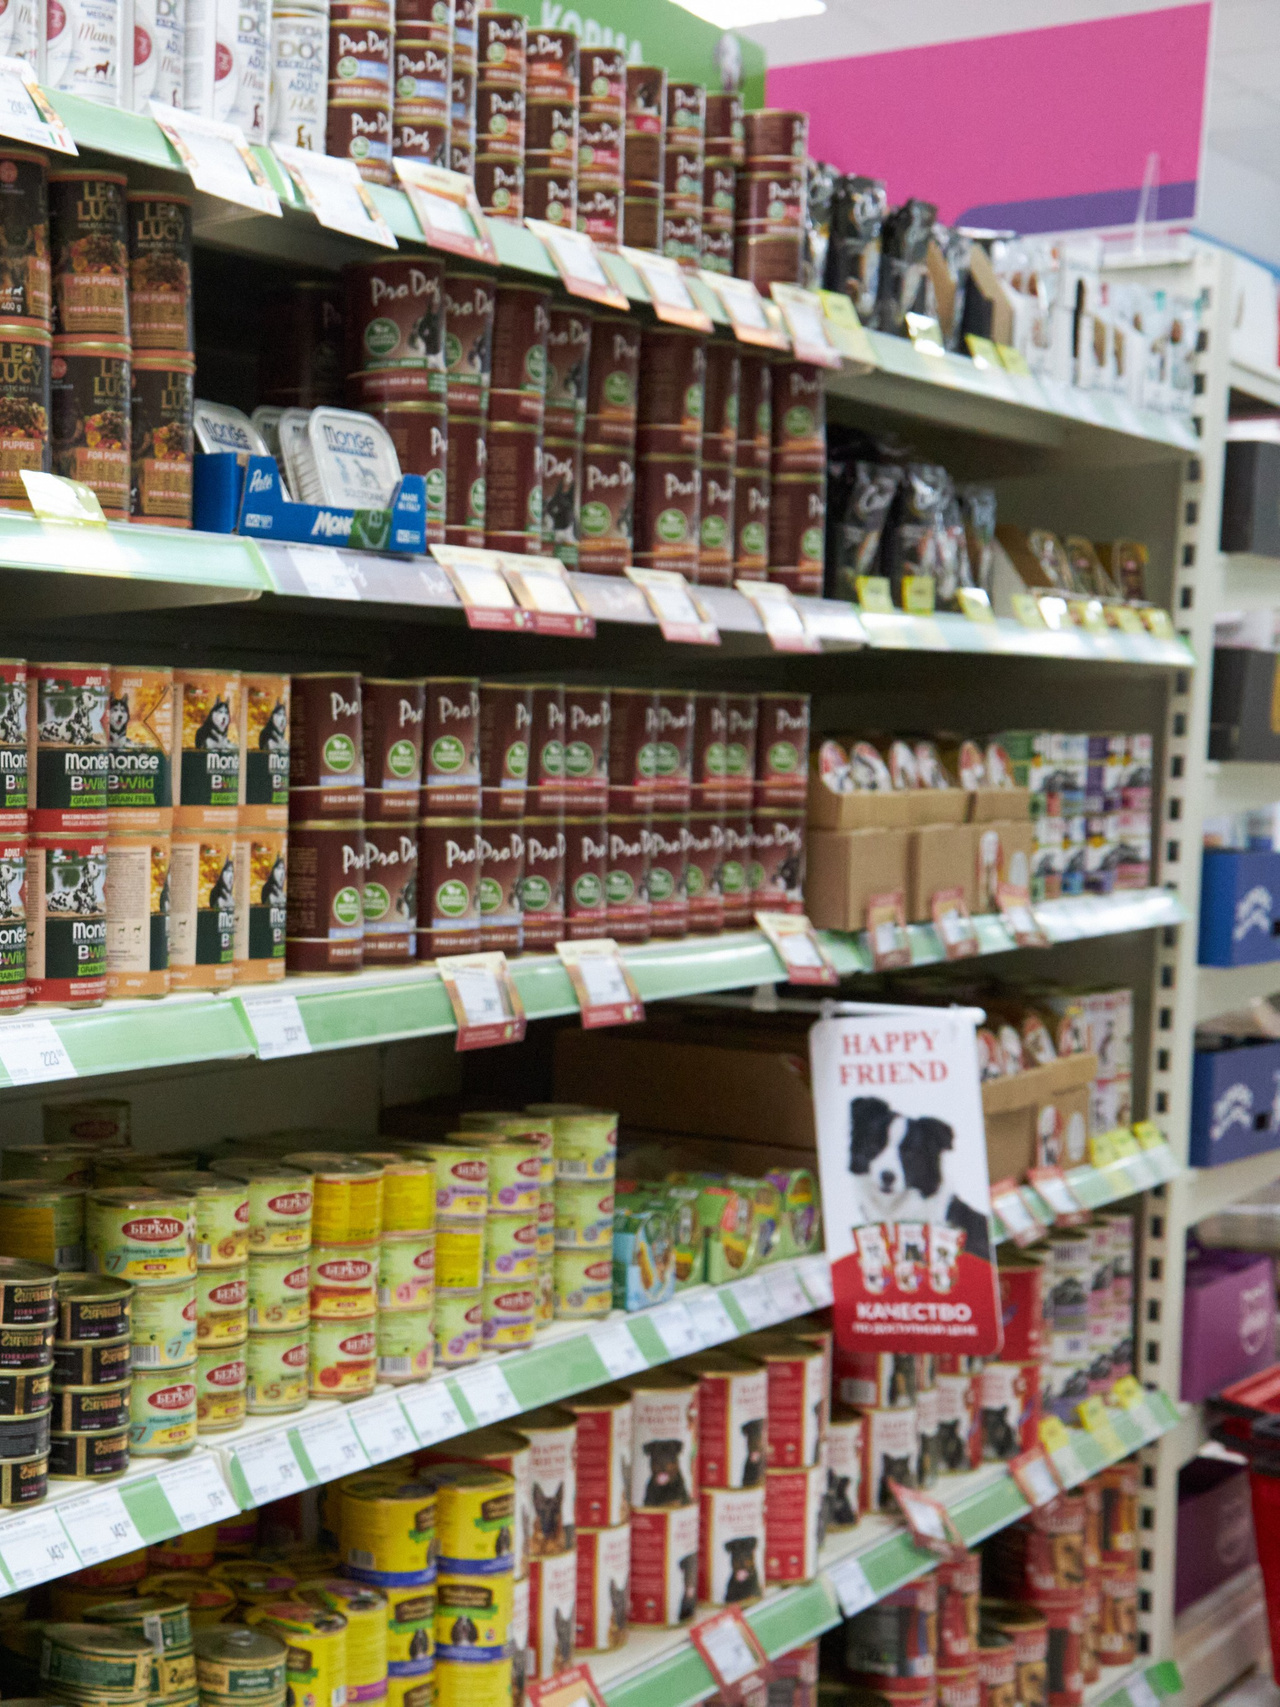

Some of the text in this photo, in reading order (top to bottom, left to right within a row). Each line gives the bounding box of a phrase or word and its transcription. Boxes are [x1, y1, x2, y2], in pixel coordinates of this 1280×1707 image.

[3, 440, 35, 451] PUPPIES
[841, 1030, 938, 1056] HAPPY
[838, 1060, 949, 1086] FRIEND
[856, 1302, 973, 1323] КАЧЕСТВО
